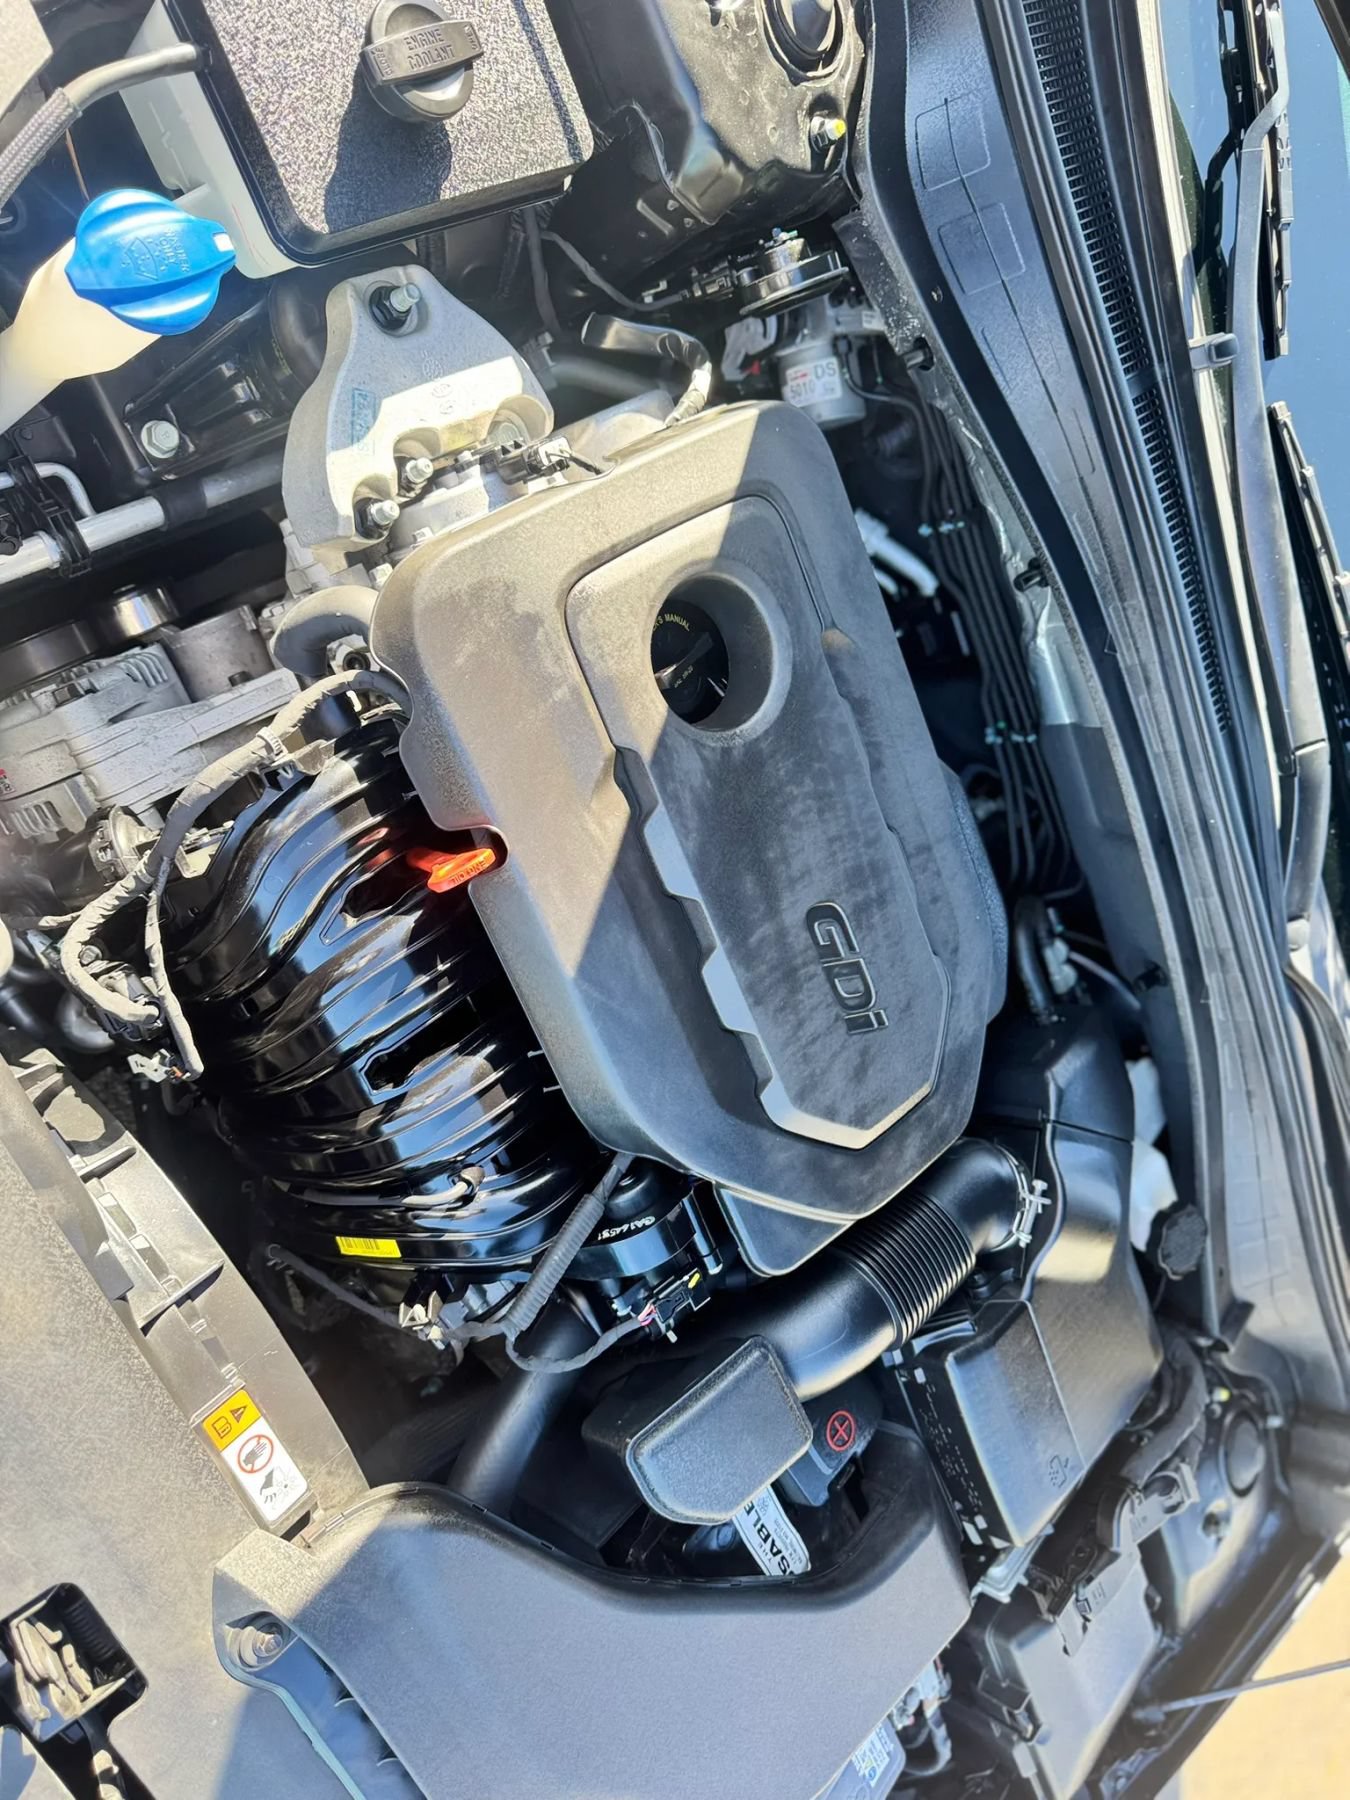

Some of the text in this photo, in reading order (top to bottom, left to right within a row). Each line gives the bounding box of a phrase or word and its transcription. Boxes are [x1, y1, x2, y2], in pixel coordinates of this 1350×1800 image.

[403, 28, 445, 51] ENGINE
[407, 44, 456, 70] COOLANT
[814, 361, 836, 380] DS
[664, 613, 690, 632] MANUAL
[743, 1500, 796, 1576] SABLE
